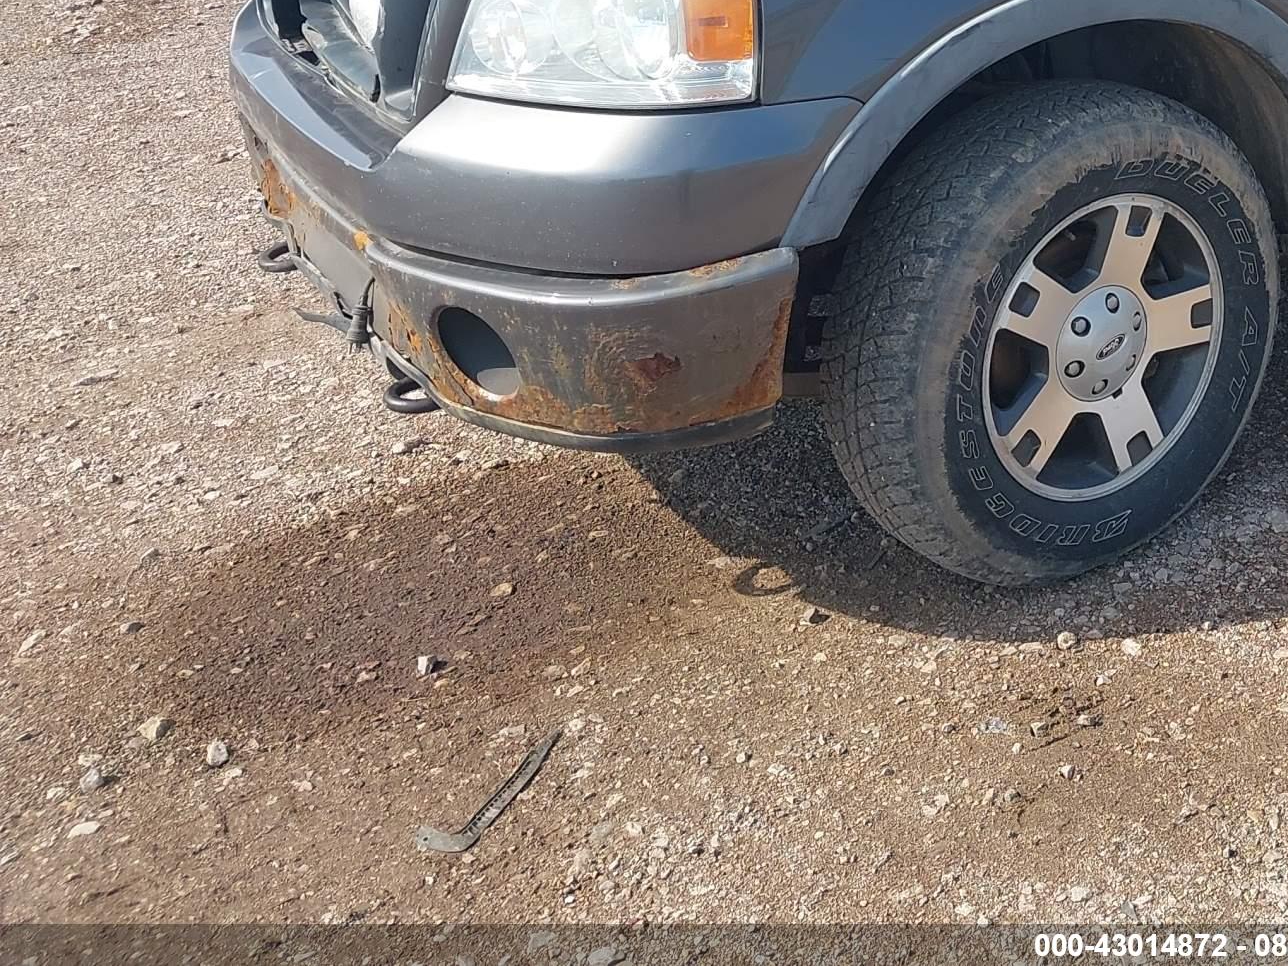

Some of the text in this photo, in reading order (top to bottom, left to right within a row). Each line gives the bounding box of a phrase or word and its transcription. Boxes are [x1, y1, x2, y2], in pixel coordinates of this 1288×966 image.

[1114, 157, 1261, 287] DUELER
[955, 259, 1133, 547] BRIDGESTONE
[1226, 305, 1261, 414] A/T
